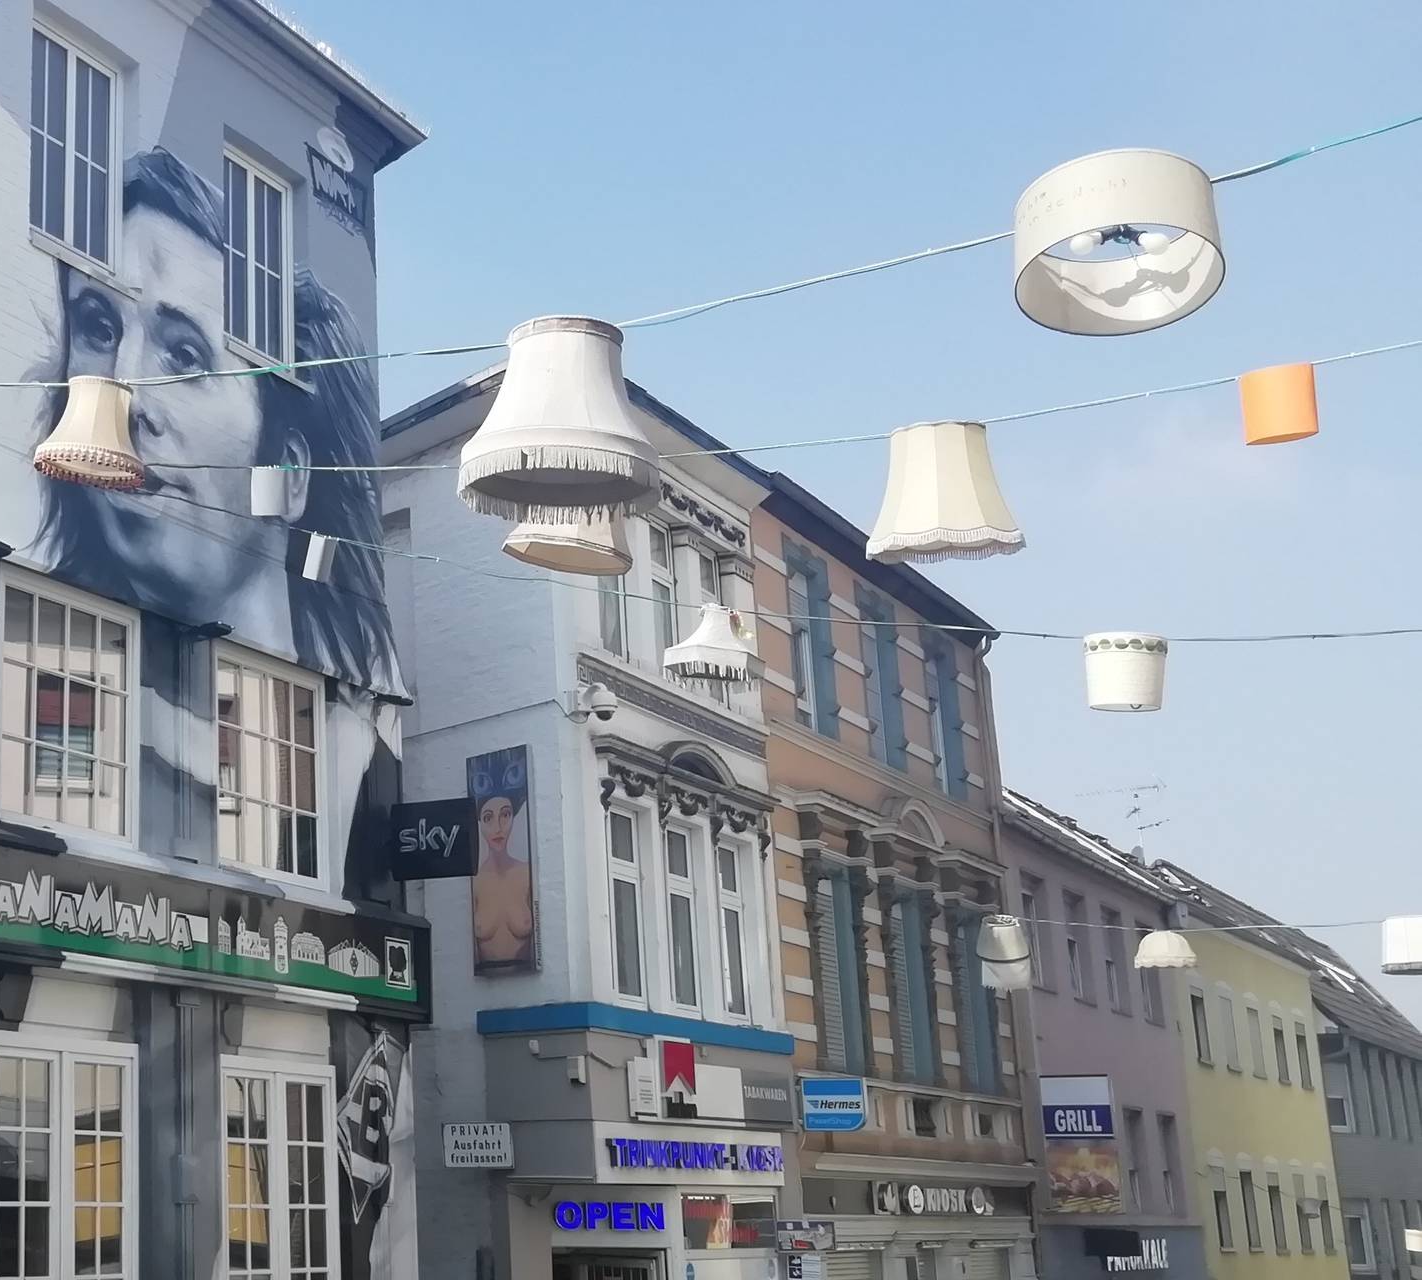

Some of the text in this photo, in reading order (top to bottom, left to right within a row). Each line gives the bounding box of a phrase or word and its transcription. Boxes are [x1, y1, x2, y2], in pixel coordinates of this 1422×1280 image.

[399, 818, 460, 857] sky
[820, 1100, 861, 1110] Hermes
[1054, 1109, 1103, 1132] GRILL
[451, 1124, 503, 1136] PRIVAT!
[453, 1139, 501, 1150] Ausfahrt
[450, 1152, 507, 1164] freilassen!
[924, 1187, 968, 1213] KIOSK
[554, 1200, 667, 1232] OPEN
